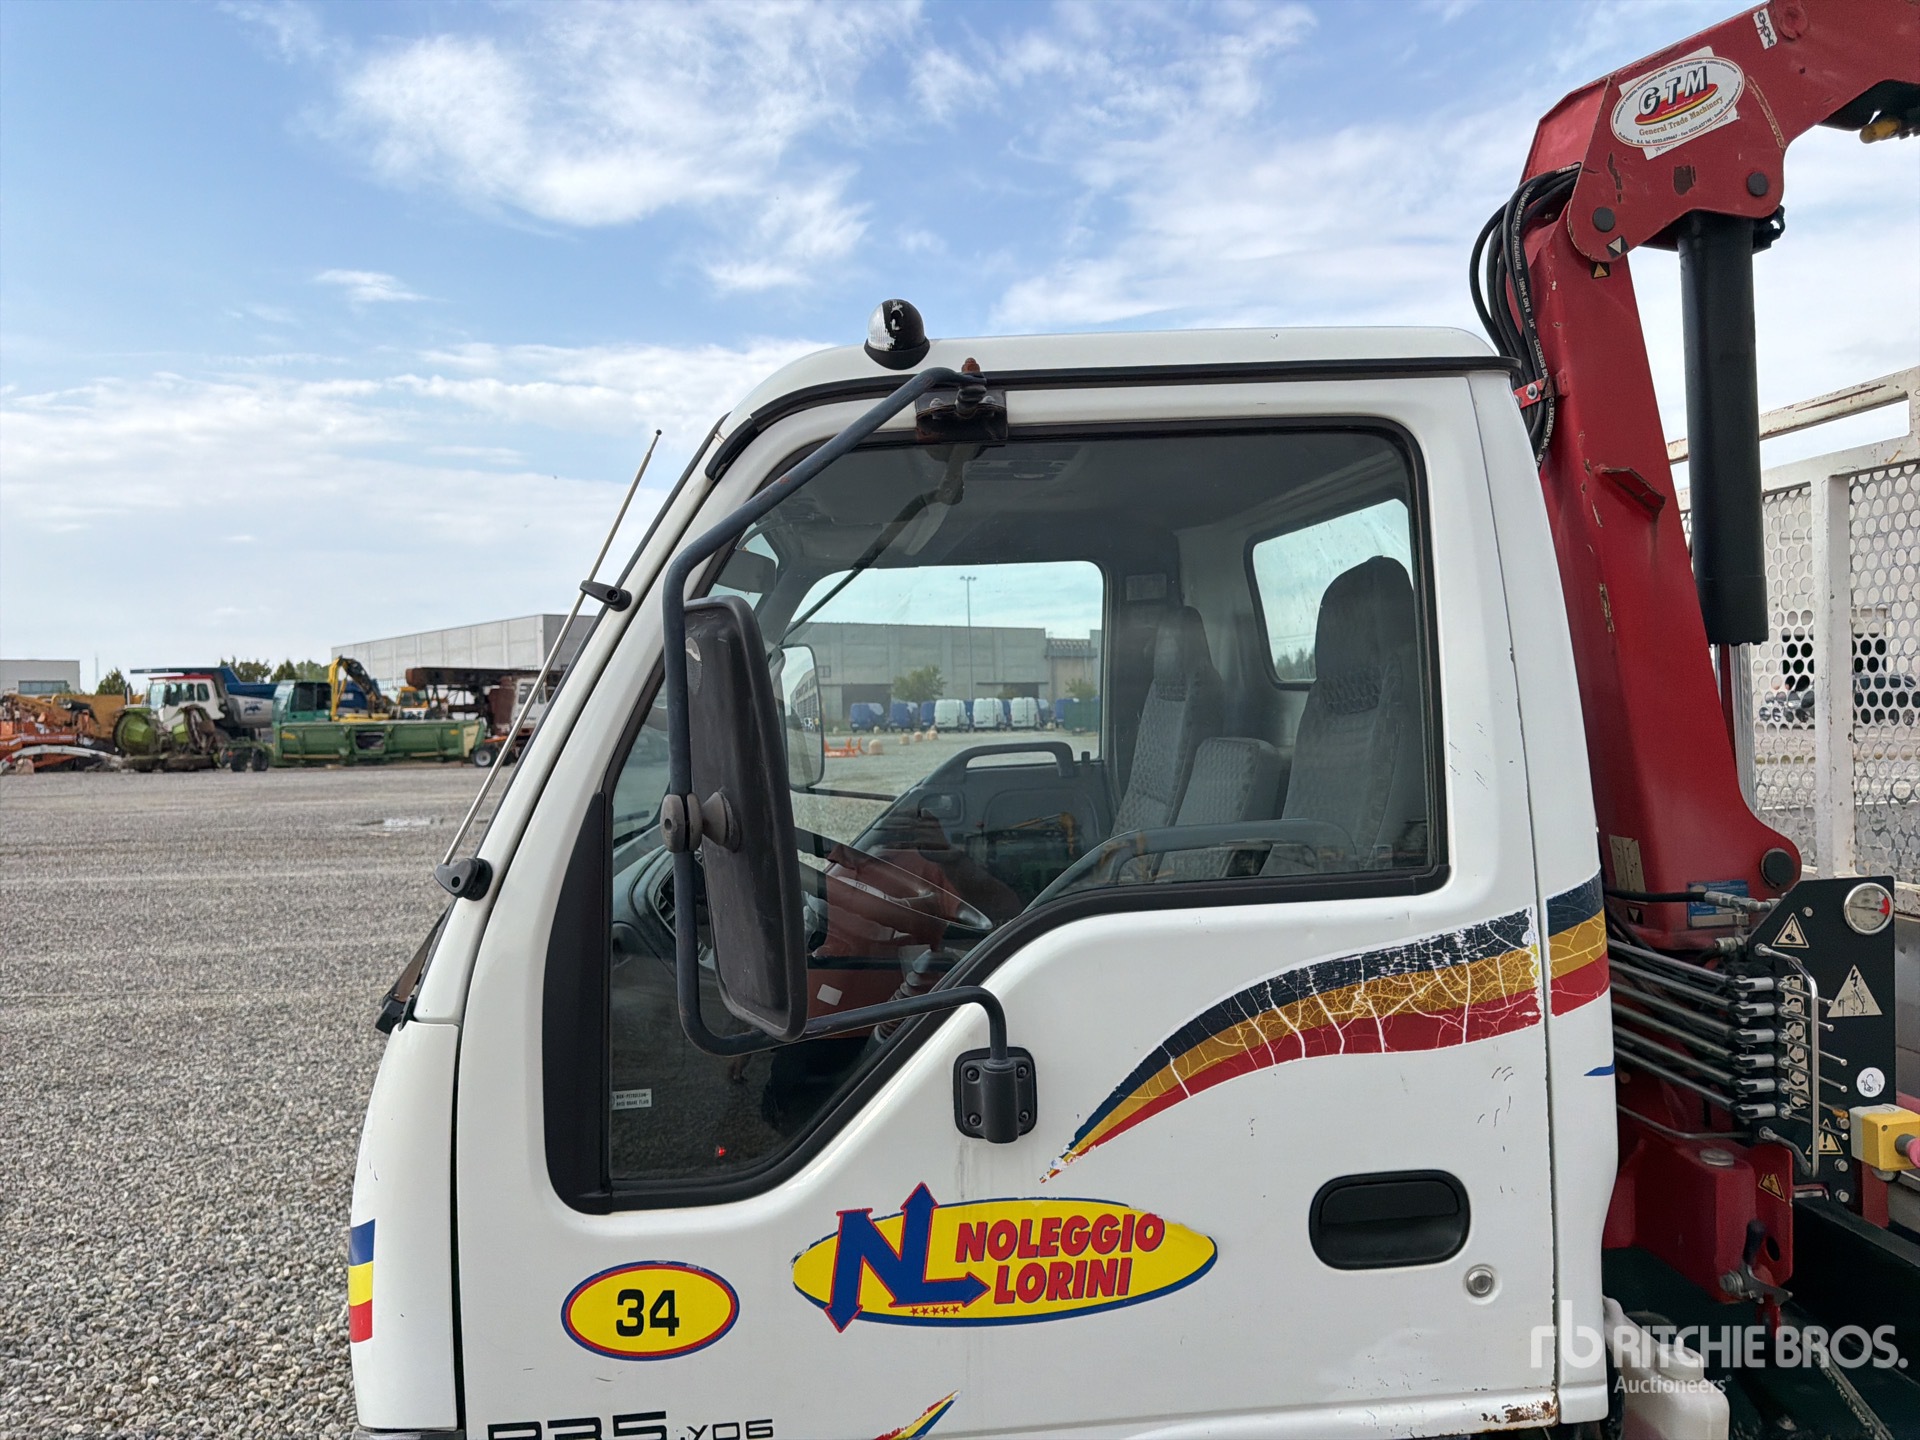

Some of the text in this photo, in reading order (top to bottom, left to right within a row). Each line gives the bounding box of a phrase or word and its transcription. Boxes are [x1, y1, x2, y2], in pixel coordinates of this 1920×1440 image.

[1639, 65, 1708, 116] GTM
[1639, 124, 1668, 136] General
[1668, 116, 1689, 130] Trade
[1689, 96, 1724, 120] Machinery
[1514, 235, 1522, 270] PREMIUM
[1534, 339, 1547, 369] EXCEEDS
[954, 1213, 1166, 1263] NOLEGGIO
[994, 1257, 1133, 1305] LORINI
[615, 1288, 680, 1337] 34
